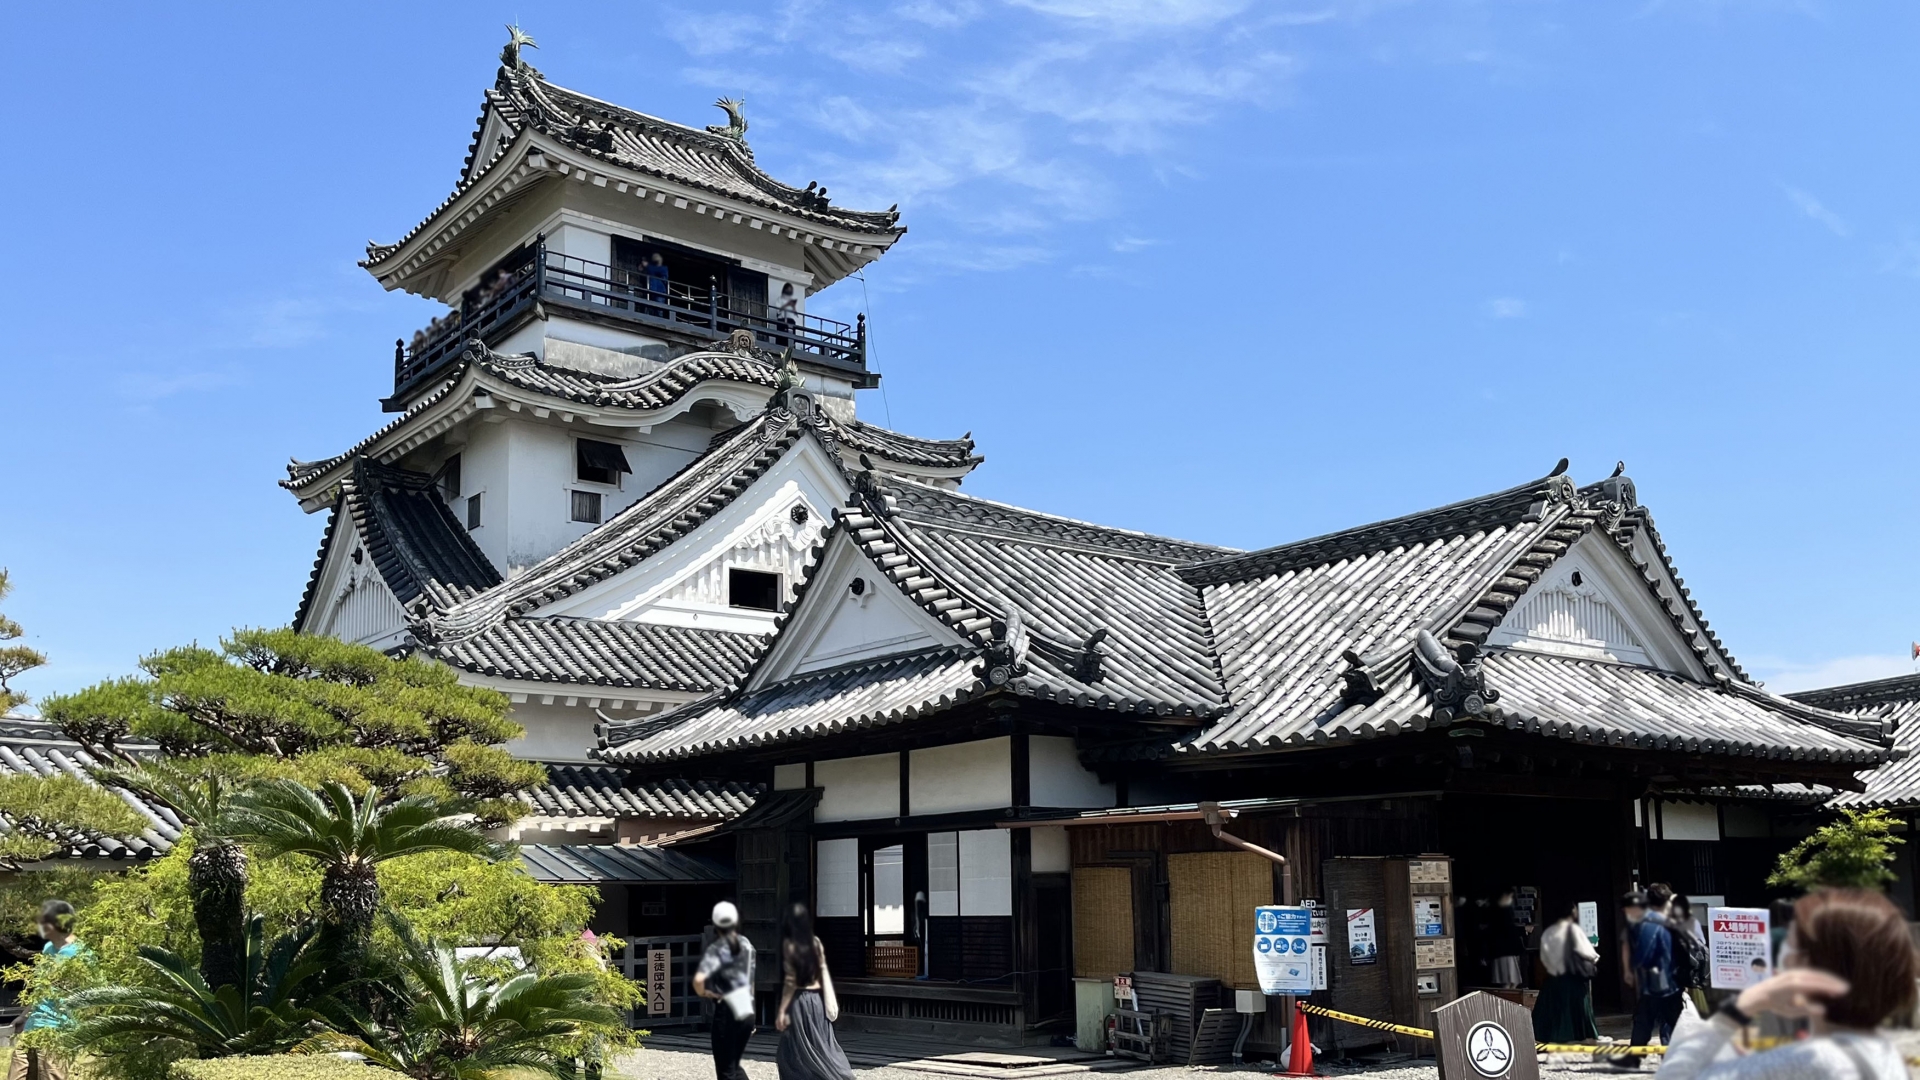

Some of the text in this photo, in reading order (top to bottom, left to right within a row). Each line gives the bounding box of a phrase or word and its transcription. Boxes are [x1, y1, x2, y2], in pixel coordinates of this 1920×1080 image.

[1300, 900, 1317, 908] AED
[1719, 922, 1759, 932] 入場制限
[653, 952, 665, 1012] 生徒団体入口
